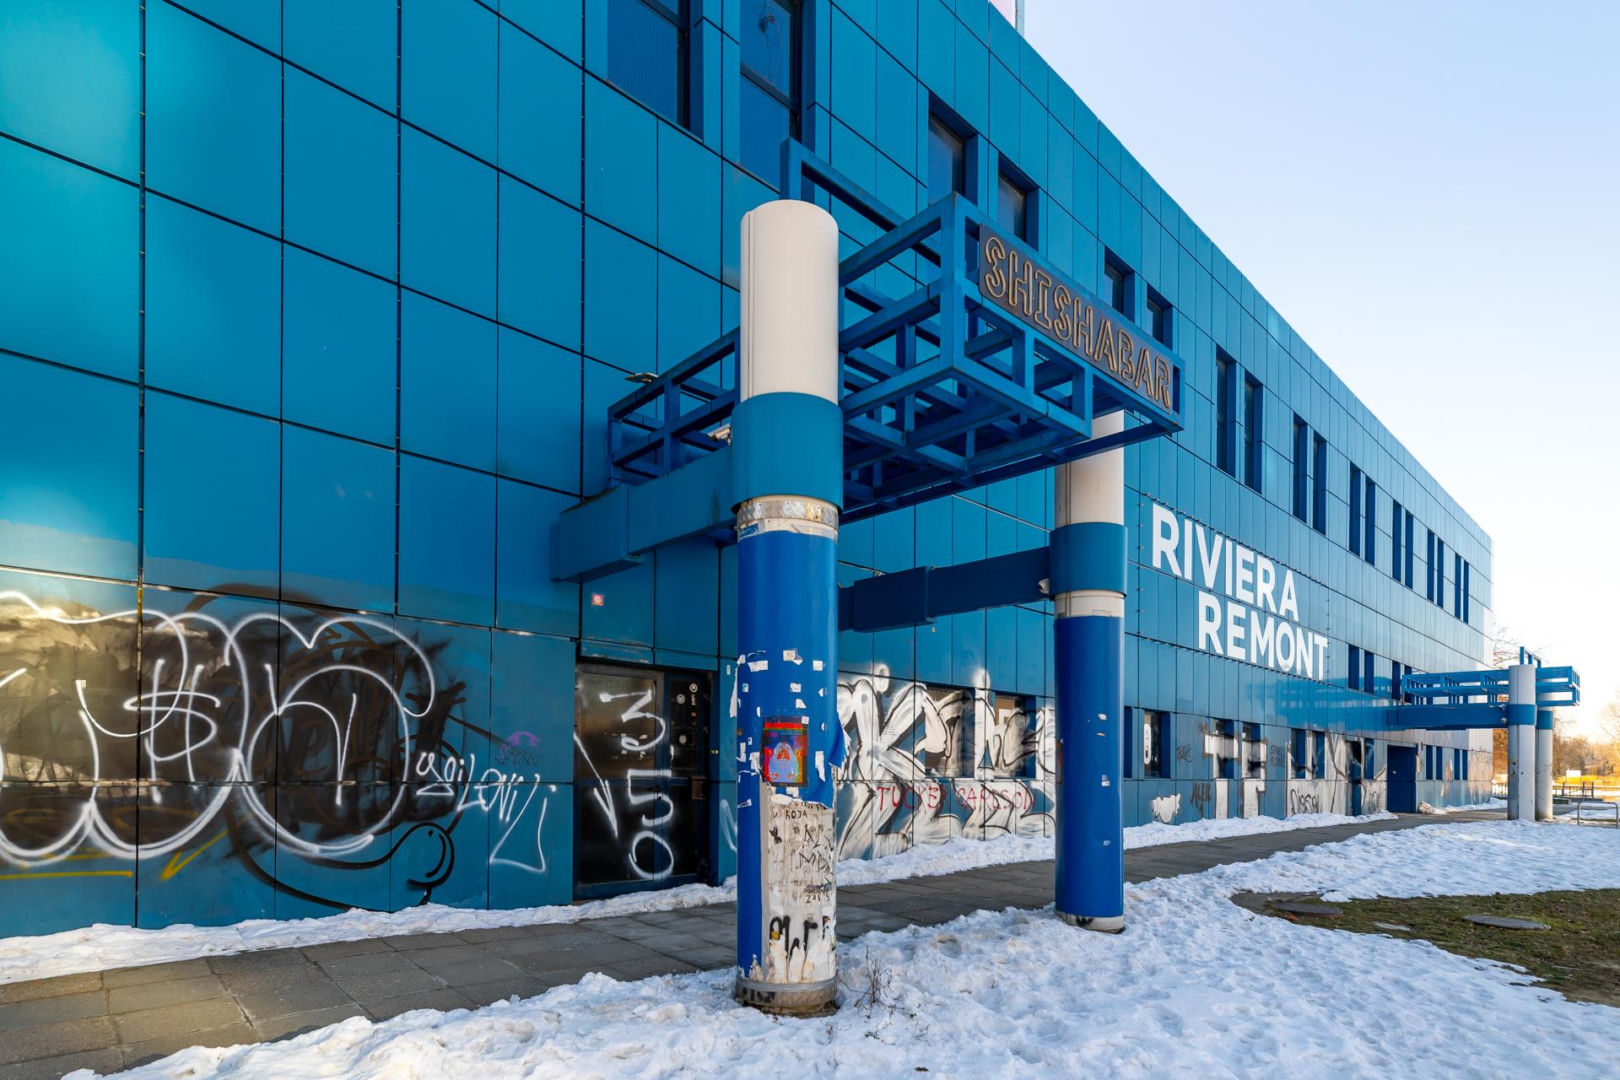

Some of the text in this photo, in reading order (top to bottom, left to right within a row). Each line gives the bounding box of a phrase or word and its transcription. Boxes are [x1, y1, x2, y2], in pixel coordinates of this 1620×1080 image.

[985, 237, 1171, 408] SHISHABAR
[1152, 503, 1299, 622] RIVIERA
[1198, 590, 1328, 681] REMONT
